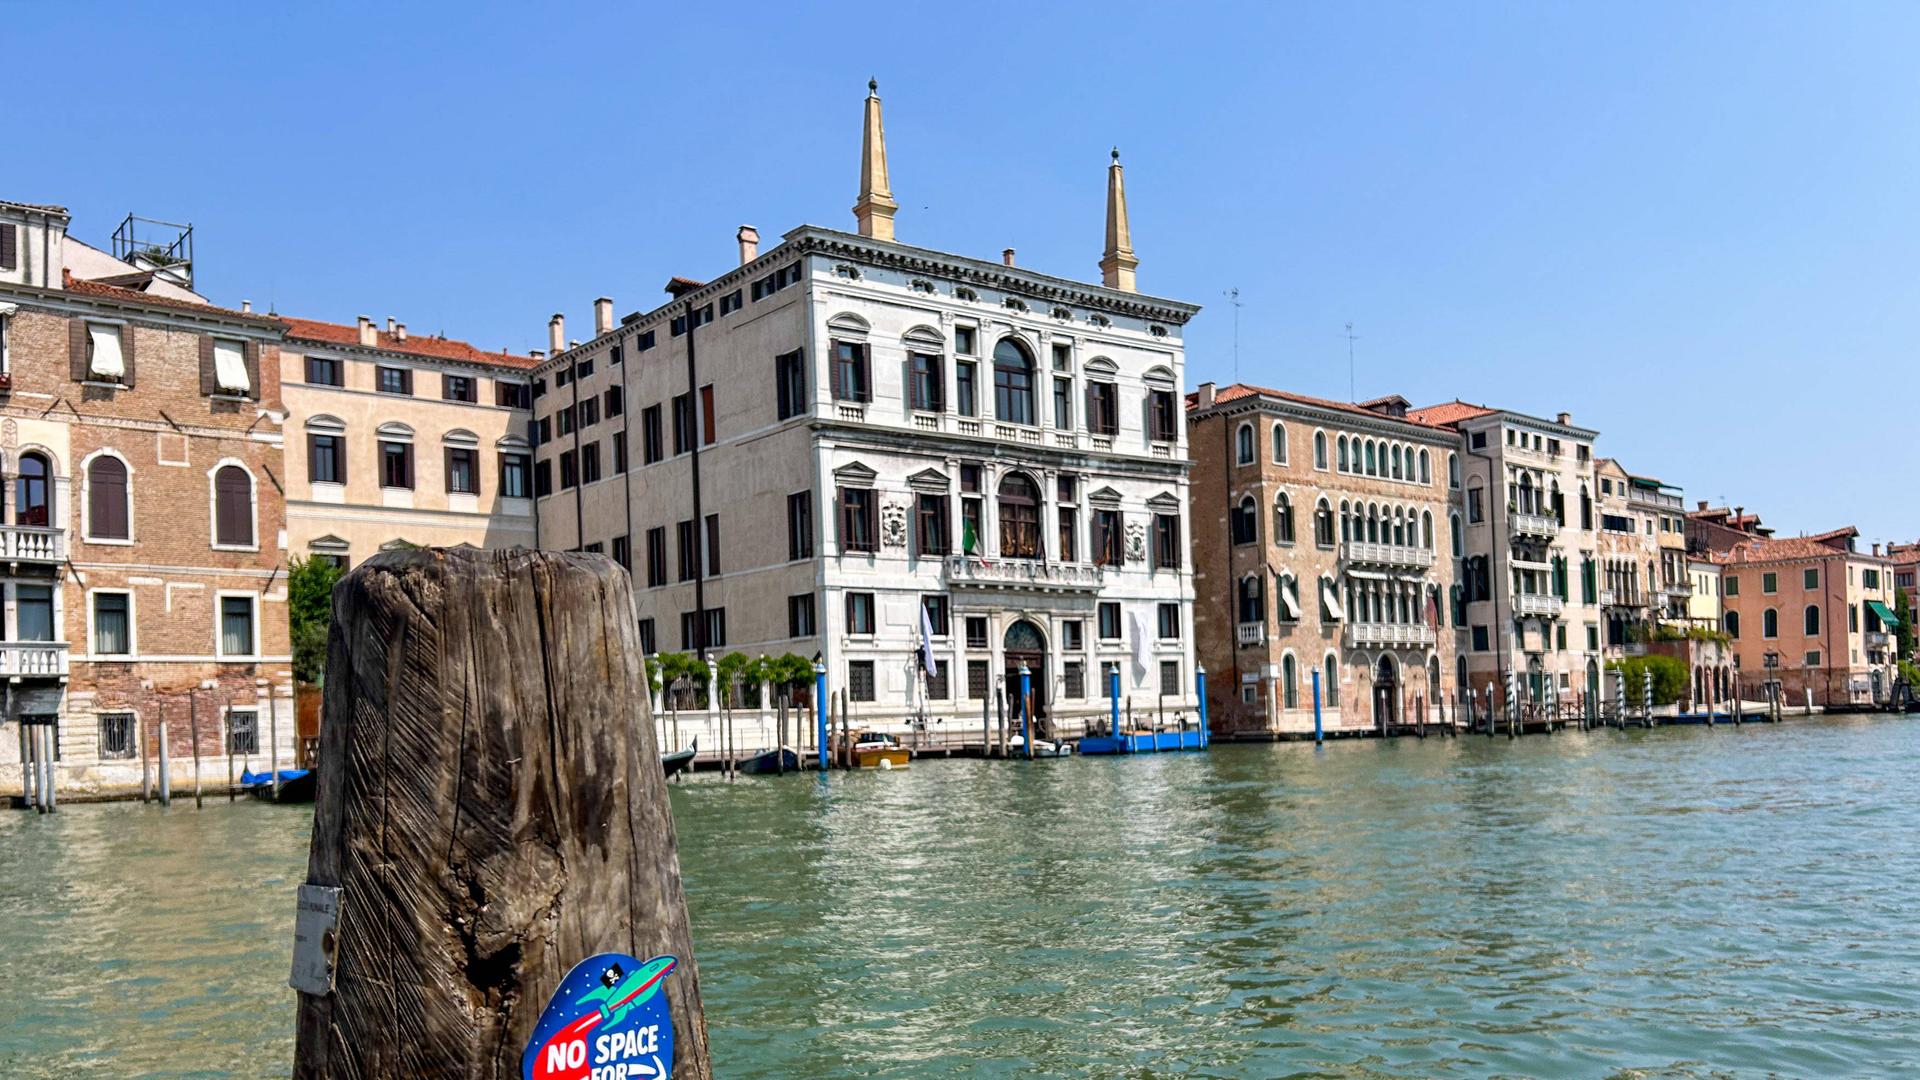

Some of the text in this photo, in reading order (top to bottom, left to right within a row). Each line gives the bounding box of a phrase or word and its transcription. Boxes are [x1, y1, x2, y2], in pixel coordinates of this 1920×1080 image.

[547, 1024, 659, 1073] NO SPACE
[591, 1063, 627, 1080] FOR
